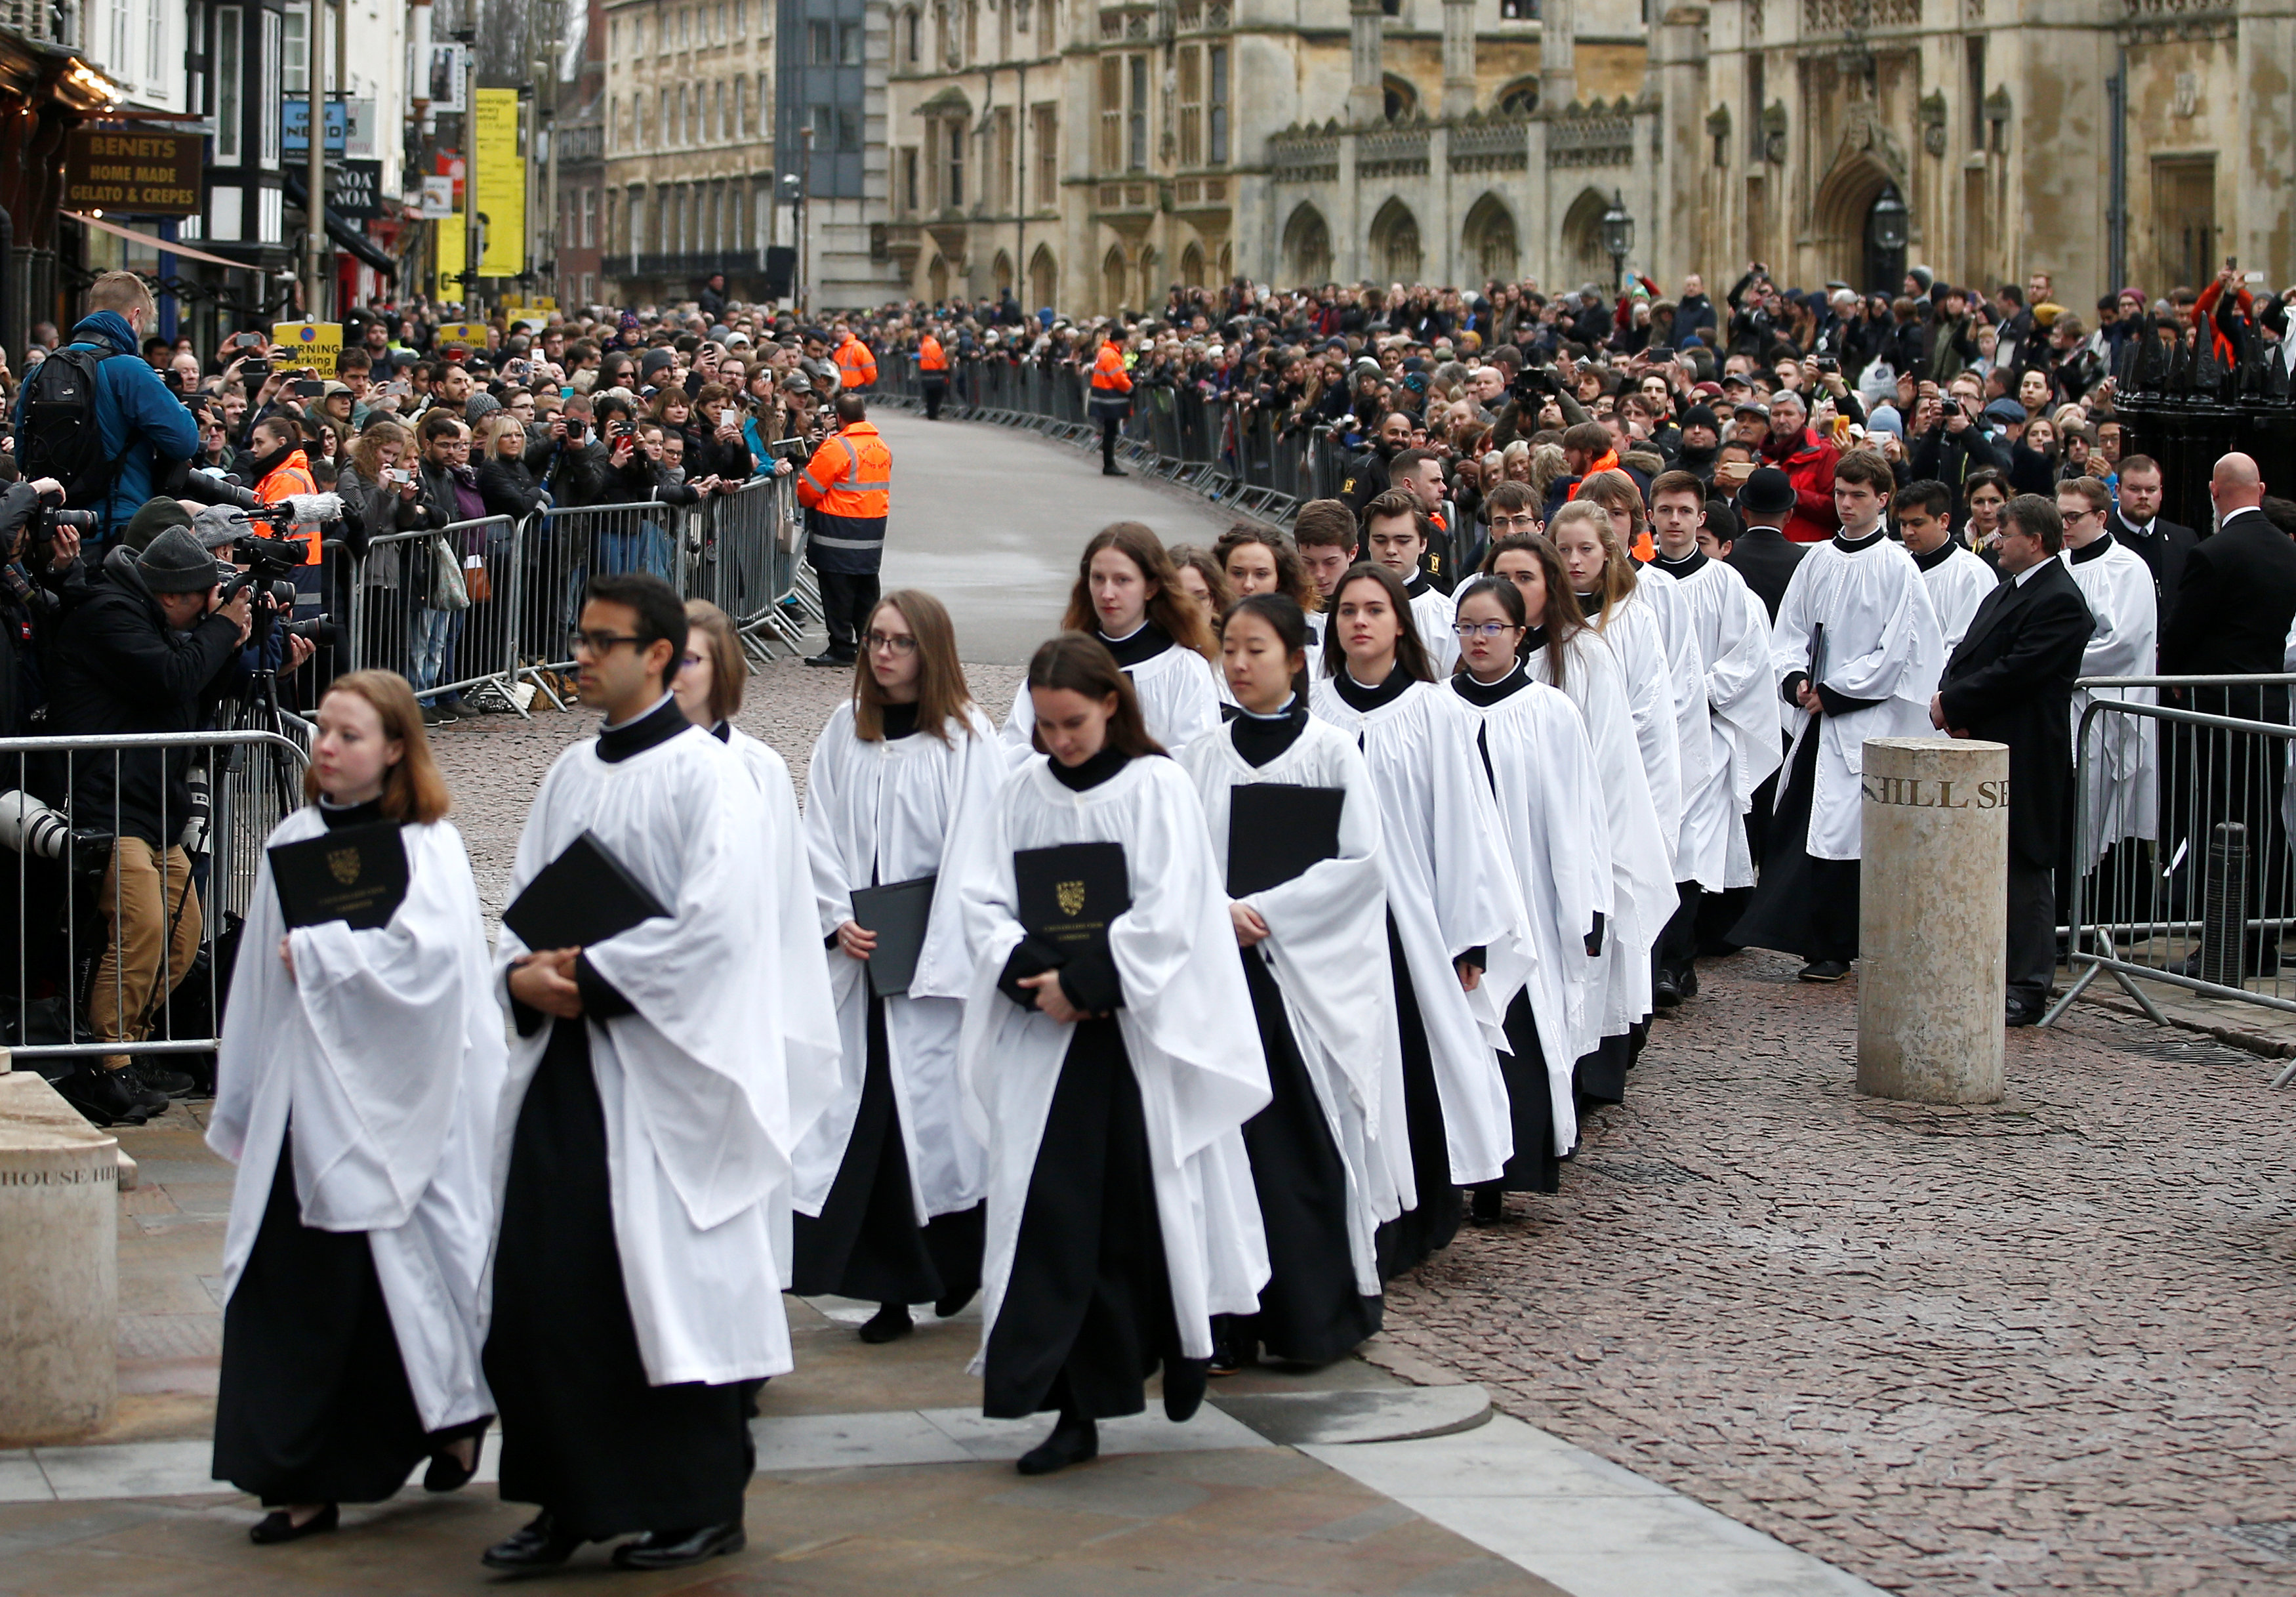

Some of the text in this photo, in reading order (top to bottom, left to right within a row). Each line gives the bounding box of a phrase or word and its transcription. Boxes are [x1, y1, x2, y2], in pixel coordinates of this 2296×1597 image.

[287, 126, 341, 137] NEO
[91, 137, 176, 158] BENETS
[90, 165, 176, 183] HOME MADE
[70, 184, 194, 205] GELATO & CREPES
[281, 344, 340, 354] RNING
[287, 356, 331, 366] arking
[2, 1170, 87, 1186] HOUSE
